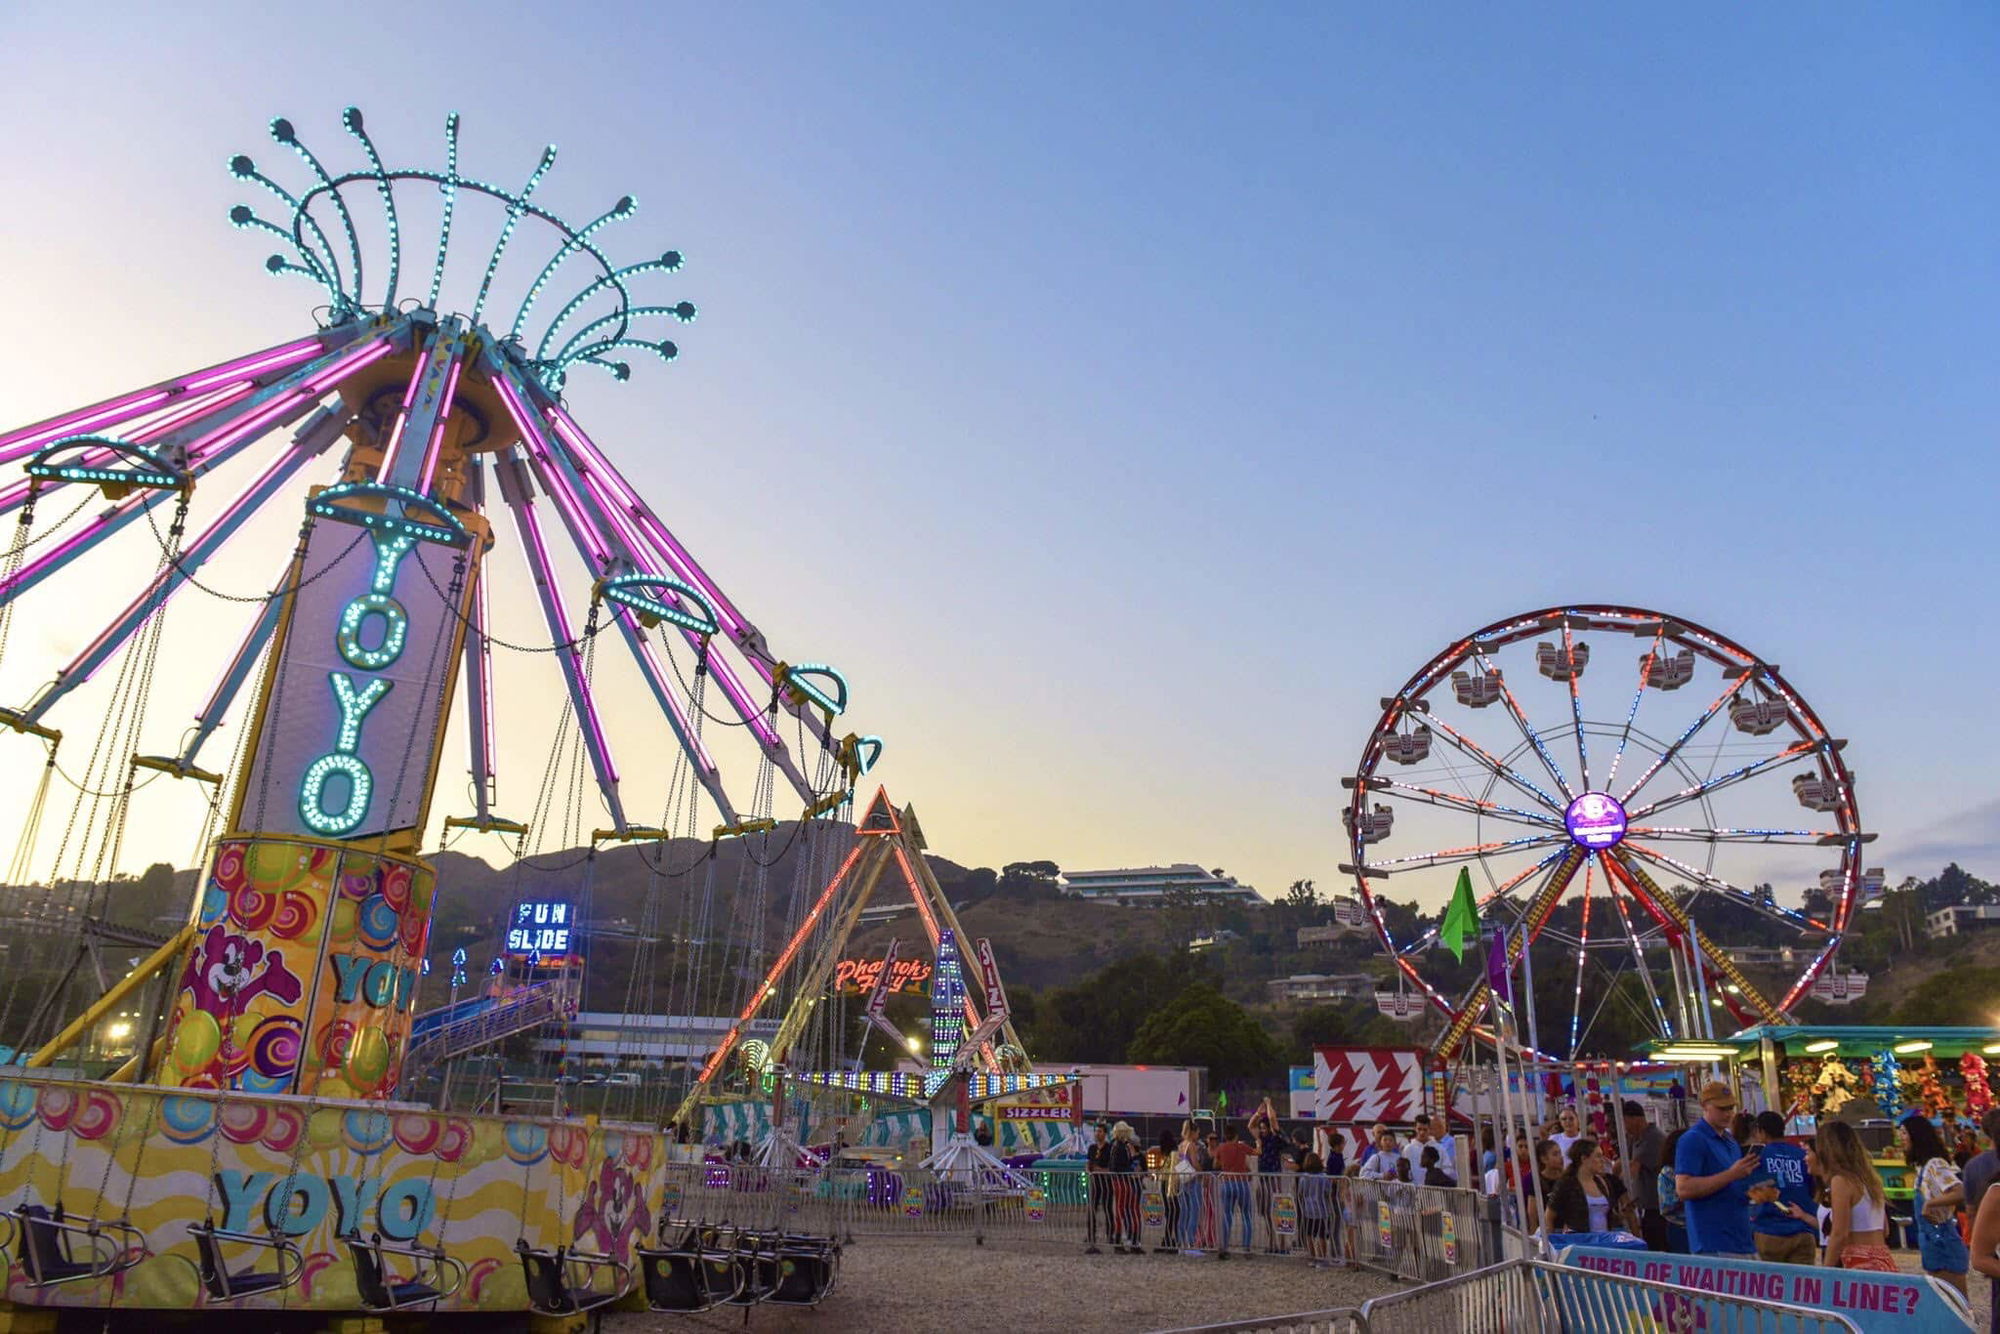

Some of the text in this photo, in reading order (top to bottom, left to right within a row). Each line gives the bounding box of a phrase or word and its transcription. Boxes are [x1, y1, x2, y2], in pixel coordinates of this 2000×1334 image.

[297, 529, 418, 836] YOYO
[518, 903, 567, 924] FUN
[508, 929, 569, 950] SLIDE
[1006, 1107, 1072, 1118] SIZZLER
[214, 1169, 437, 1243] YOYO
[1678, 1265, 1785, 1300] WAITING
[1792, 1275, 1822, 1304] IN
[1832, 1280, 1921, 1316] LINE?
